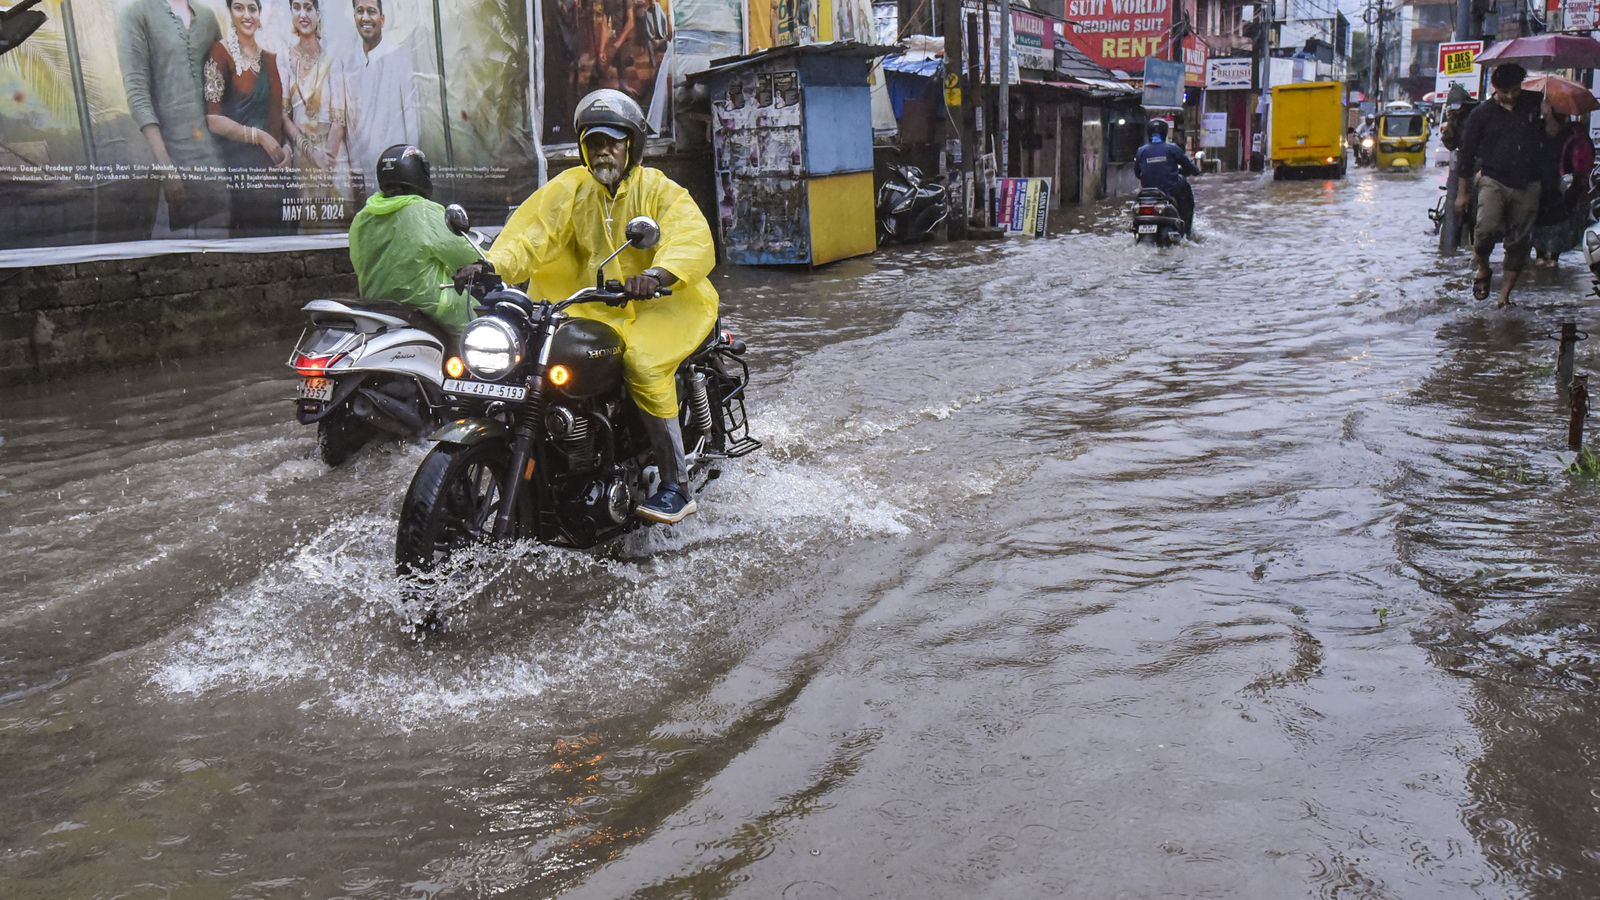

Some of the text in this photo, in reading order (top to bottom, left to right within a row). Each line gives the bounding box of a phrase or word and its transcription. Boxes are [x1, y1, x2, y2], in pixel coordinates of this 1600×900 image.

[1069, 0, 1167, 16] SUIT WORLD
[1134, 18, 1164, 31] SUIT
[1102, 36, 1162, 58] RENT
[1217, 69, 1251, 77] BRITISH
[20, 164, 42, 173] Deepu
[45, 164, 73, 173] Pradeep
[90, 164, 113, 173] Neeraj
[74, 173, 93, 182] Rinny
[282, 203, 344, 222] MAY 16, 2024
[586, 346, 621, 359] HONDA
[454, 381, 524, 399] KL 43 P 5193
